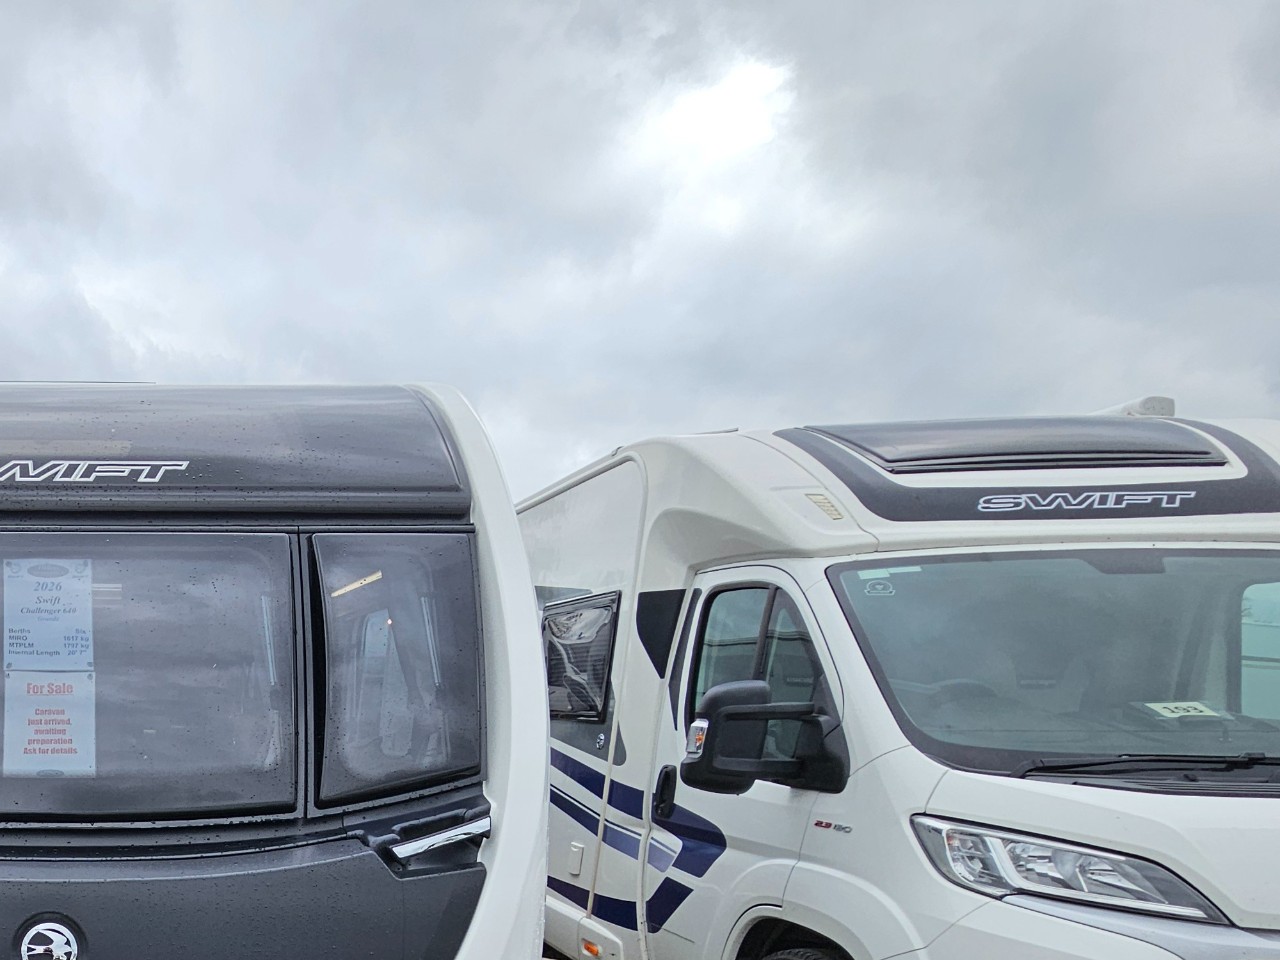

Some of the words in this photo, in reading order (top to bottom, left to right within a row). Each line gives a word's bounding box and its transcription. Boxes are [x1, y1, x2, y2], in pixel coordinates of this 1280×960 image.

[977, 491, 1197, 512] SWIFT
[33, 581, 62, 592] 2026
[35, 596, 61, 606] Swift
[20, 607, 61, 615] Challenger
[26, 682, 46, 694] For
[47, 682, 74, 694] Sale
[34, 708, 65, 716] Caravan
[27, 737, 73, 745] preparation
[23, 747, 37, 755] Ask
[38, 747, 50, 755] for
